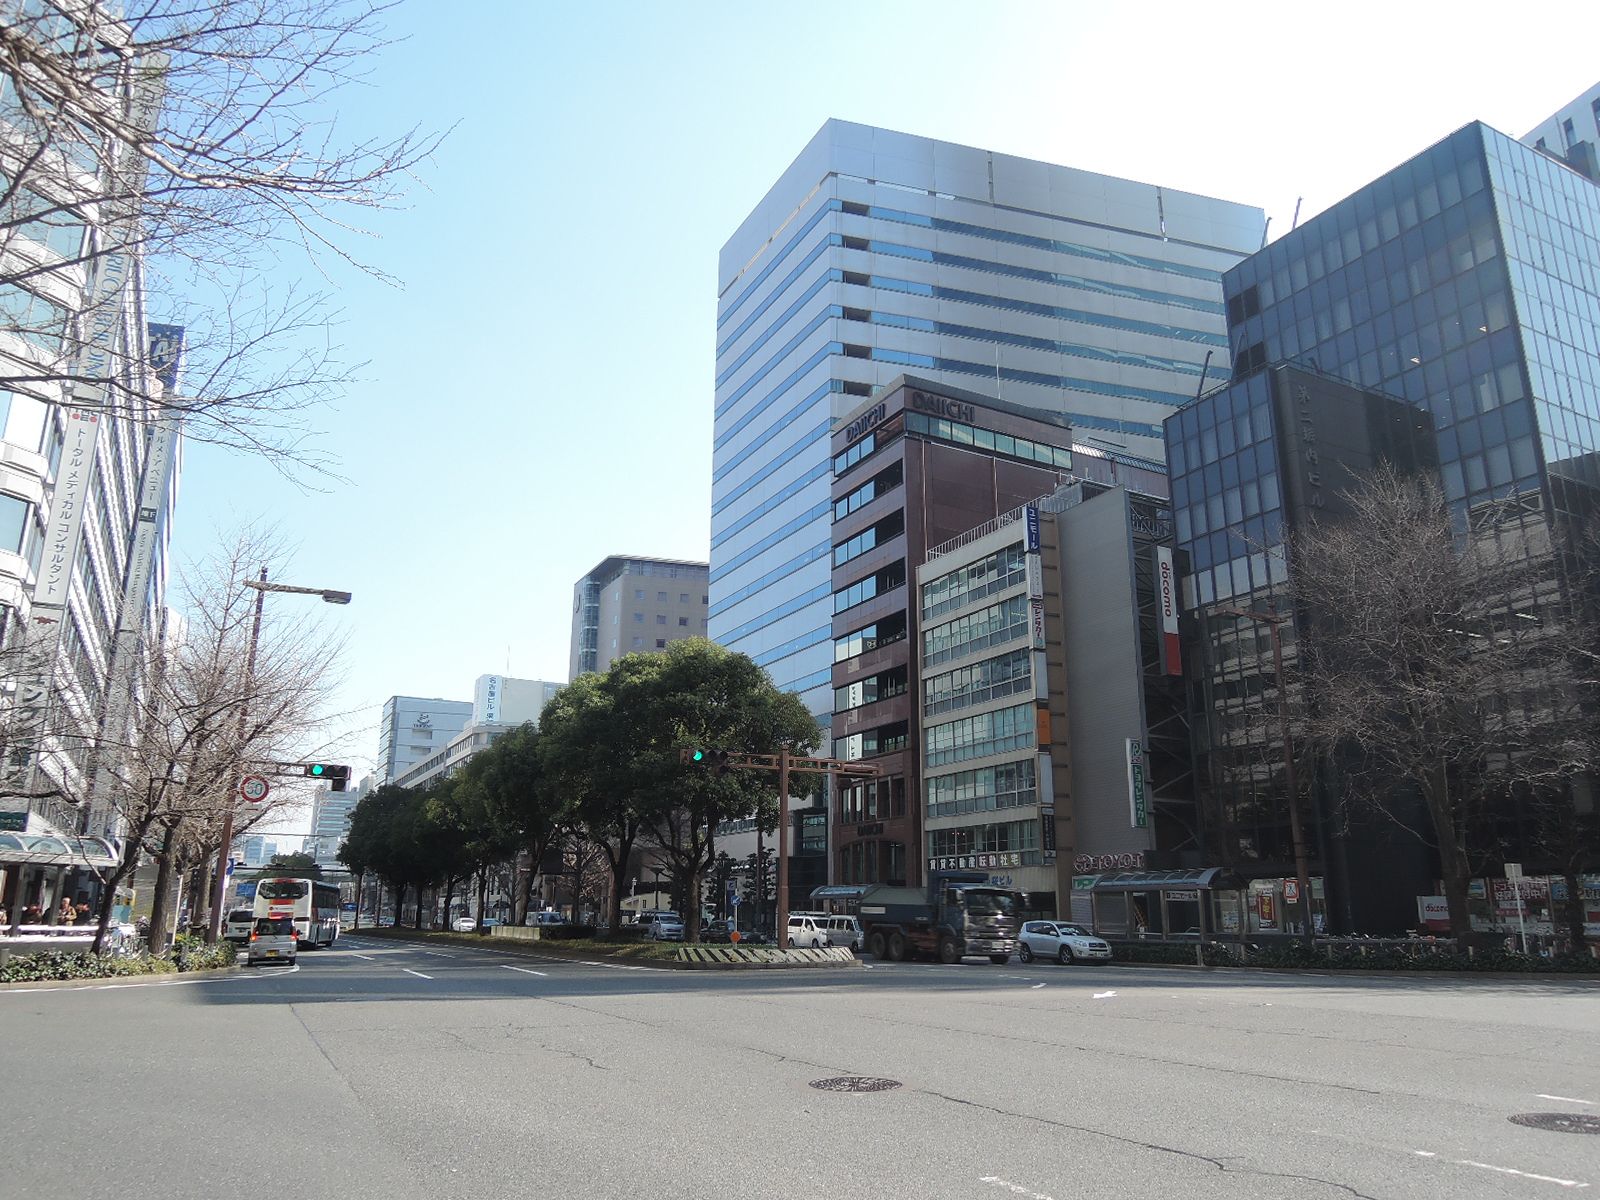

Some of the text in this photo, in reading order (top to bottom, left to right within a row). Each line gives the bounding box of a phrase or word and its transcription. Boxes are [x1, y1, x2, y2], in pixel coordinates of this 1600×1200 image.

[847, 403, 886, 442] DAIICHI
[912, 391, 975, 422] DAIICHI
[1161, 561, 1171, 617] docomo
[246, 782, 263, 795] 50
